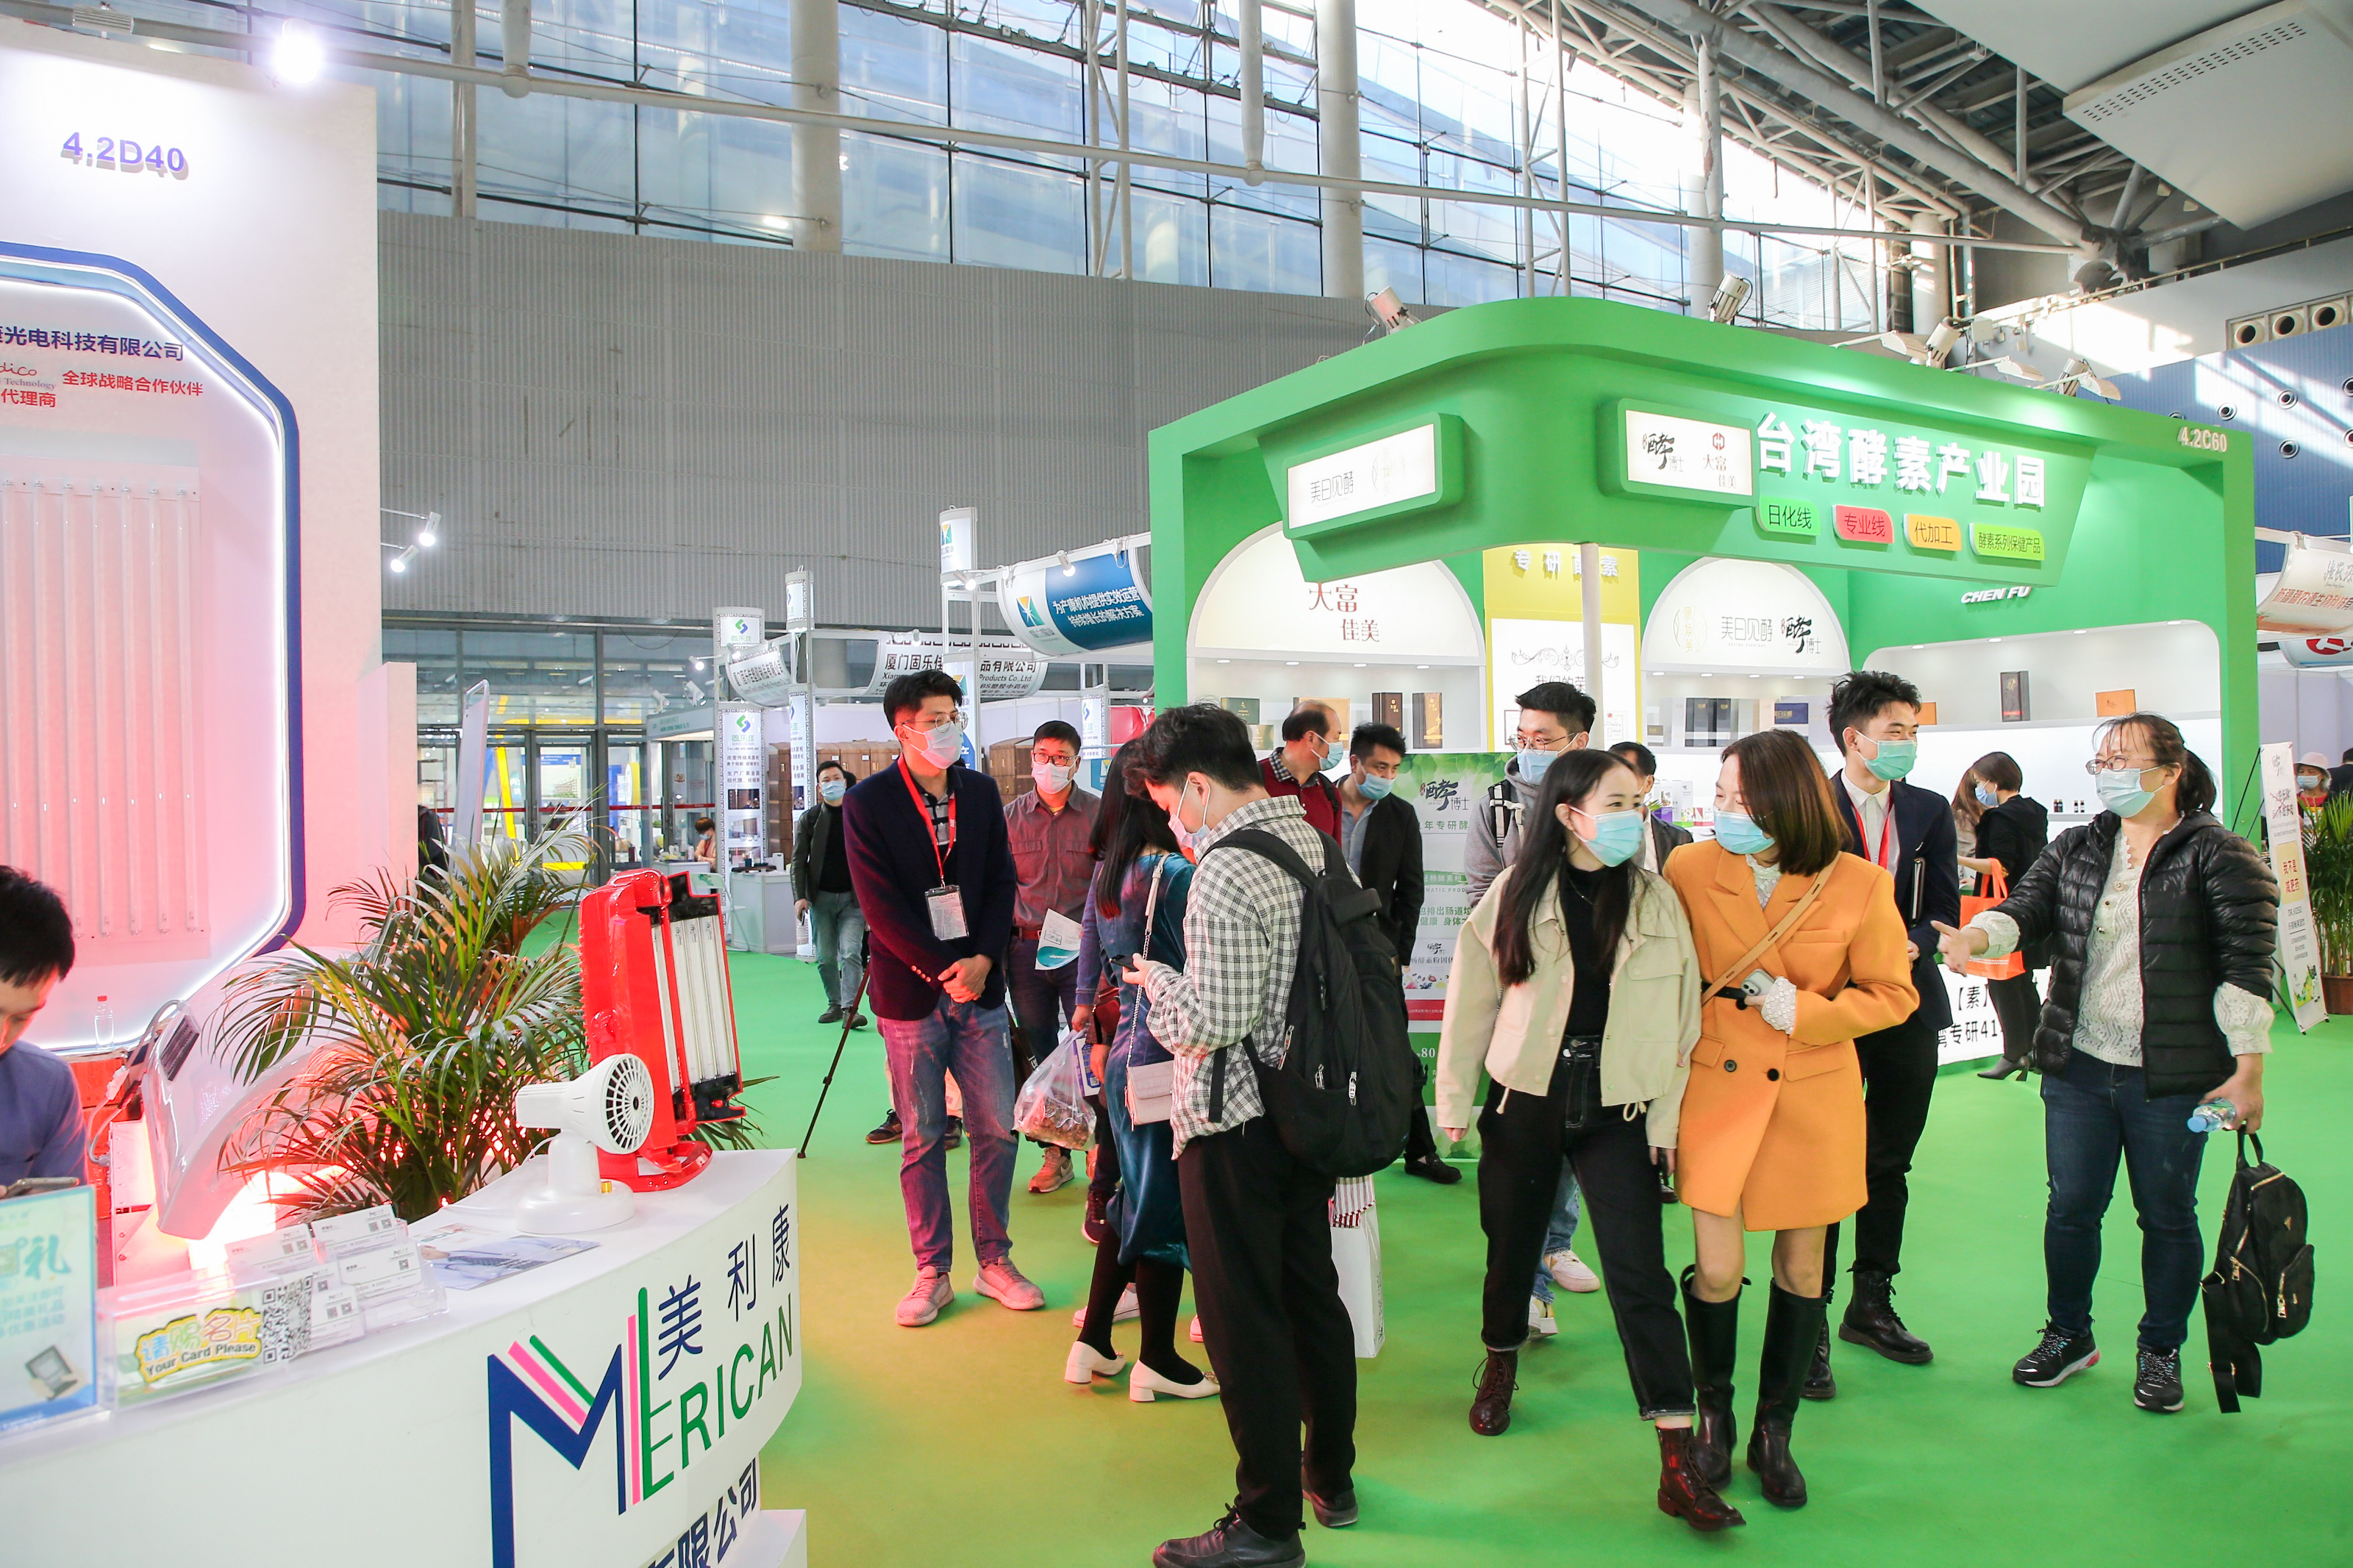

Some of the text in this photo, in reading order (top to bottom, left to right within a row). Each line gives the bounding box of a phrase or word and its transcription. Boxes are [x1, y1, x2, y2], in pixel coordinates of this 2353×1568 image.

[62, 132, 185, 175] 4.2D40
[4, 377, 57, 390] Technology
[62, 370, 204, 396] 全球战略合作伙伴
[1, 388, 57, 408] 代理商
[2179, 426, 2227, 452] 4.2C60
[1702, 454, 1727, 472] 大富
[1757, 411, 2046, 508] 台湾酵素产业园
[1718, 474, 1737, 490] 佳美
[1768, 504, 1813, 530] 日化线
[1843, 512, 1886, 537] 专业线
[1914, 521, 1954, 545] 代加工
[1977, 531, 2041, 555] 酵素系列保健产品
[1051, 586, 1141, 615] 为产康机构提供实效运营
[1309, 583, 1358, 613] 大富
[1960, 585, 2033, 605] CHEN FU
[1067, 604, 1145, 628] 持续增长的解决方案
[1340, 618, 1380, 642] 佳美
[1721, 616, 1773, 642] 美日见酵
[885, 654, 943, 670] 厦门固乐佳
[1418, 917, 1438, 926] 健康
[146, 1343, 257, 1376] Your Card Please
